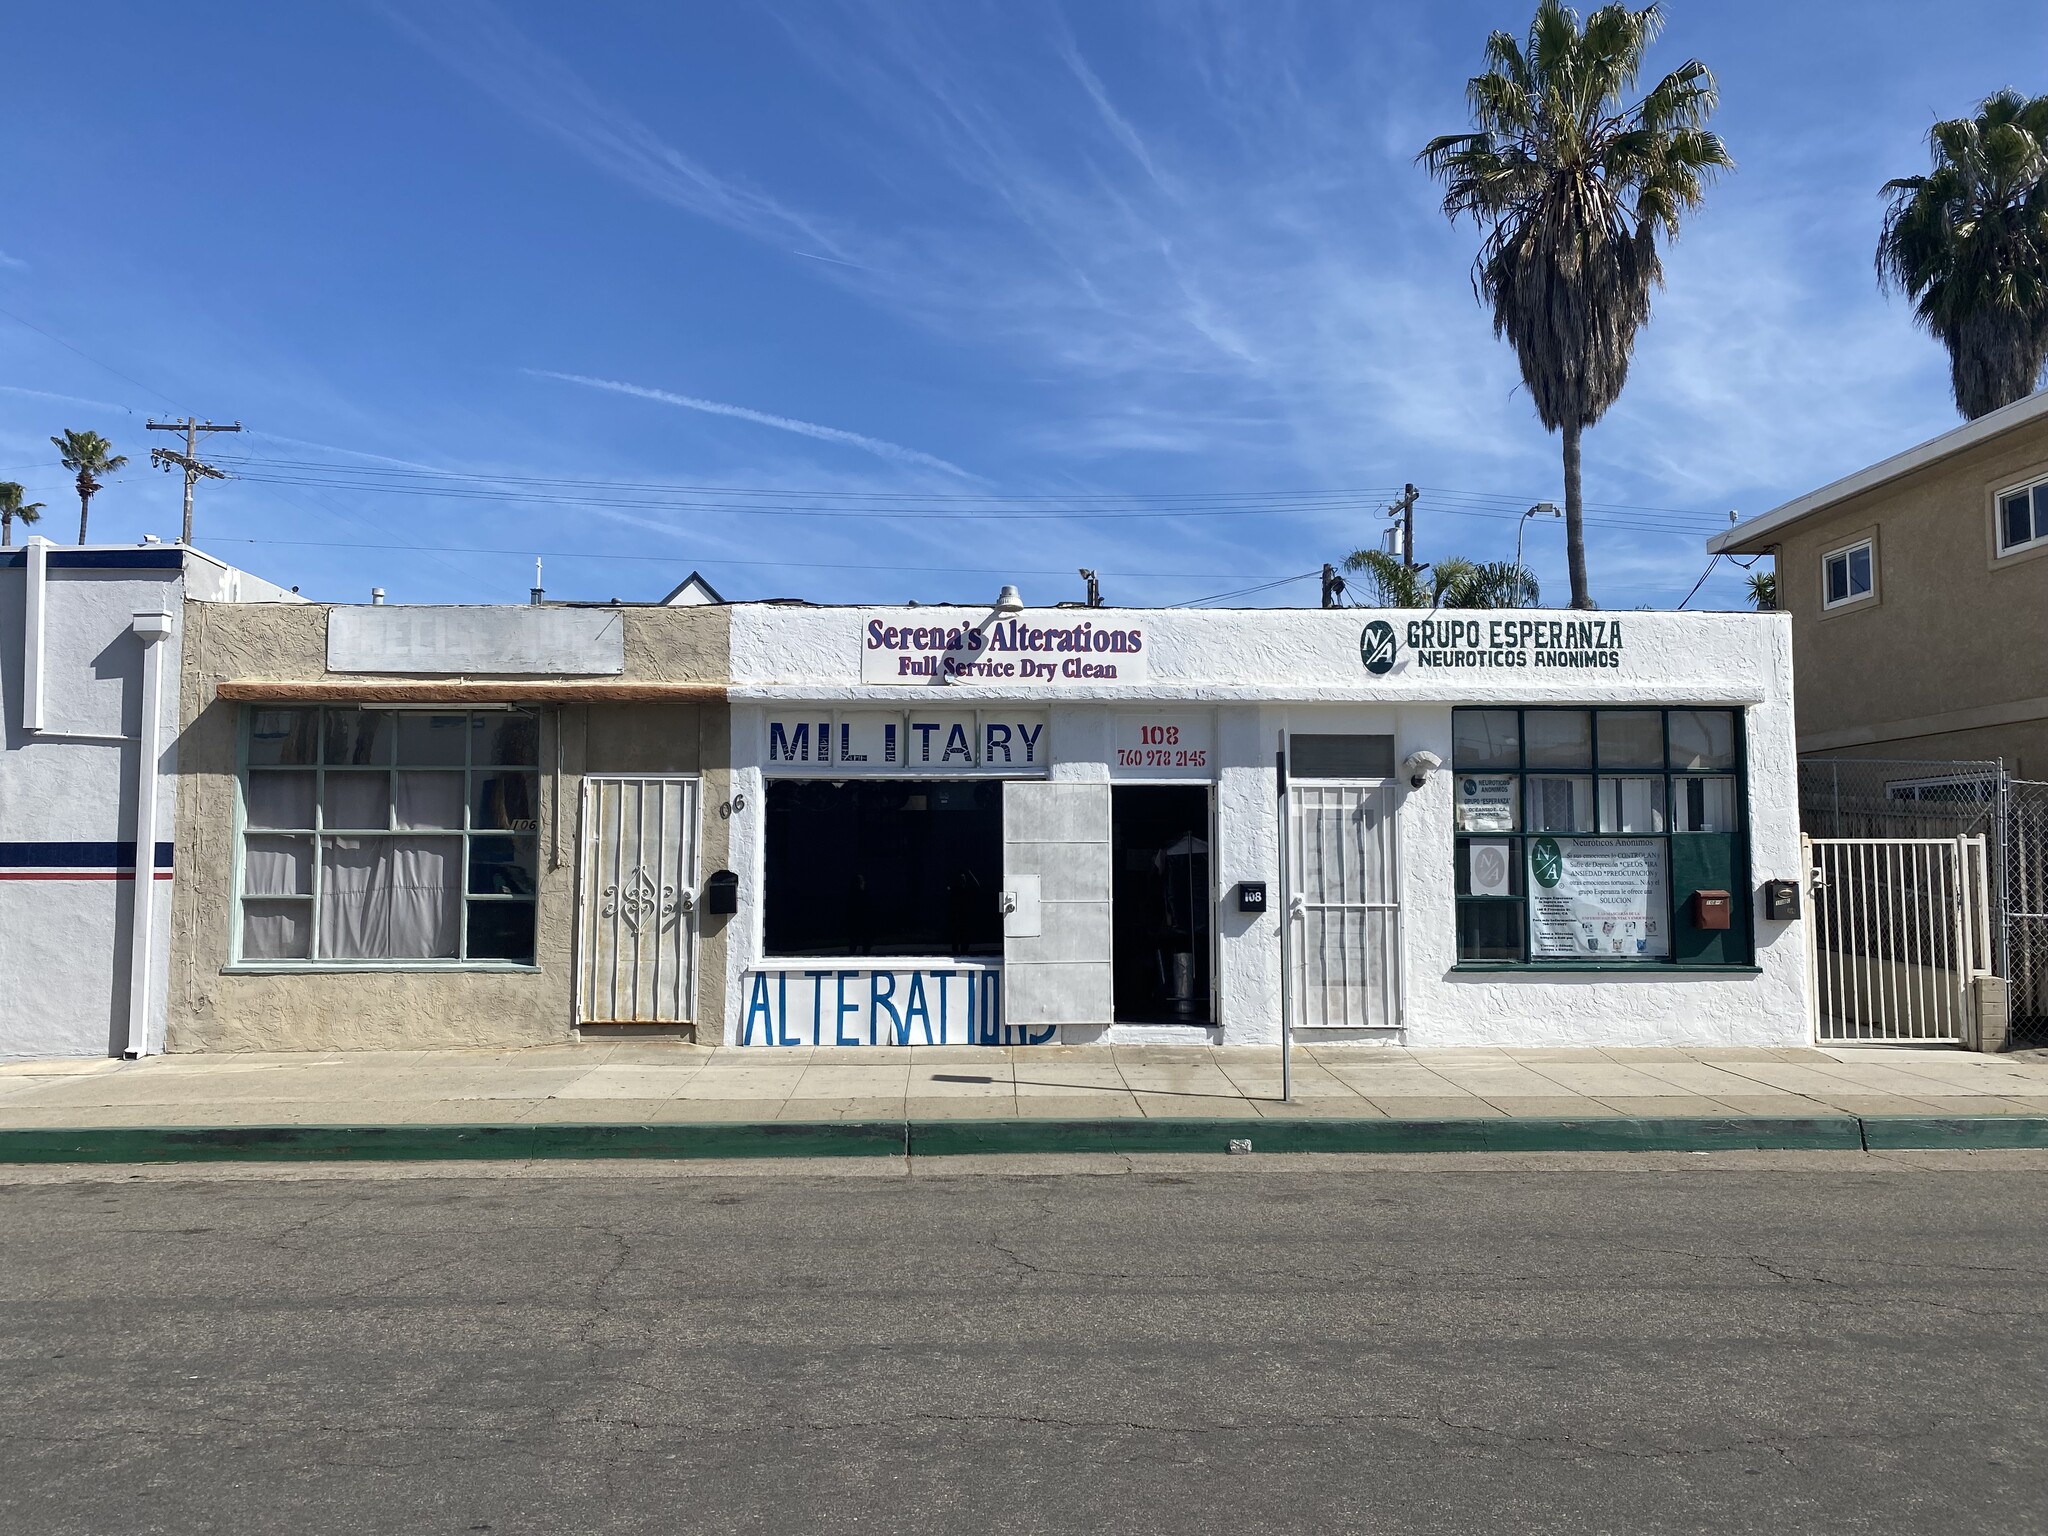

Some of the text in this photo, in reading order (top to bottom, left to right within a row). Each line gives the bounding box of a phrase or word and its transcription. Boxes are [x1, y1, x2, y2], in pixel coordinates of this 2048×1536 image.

[867, 619, 1142, 653] Serena's Alterations
[1407, 620, 1623, 649] GRUPO ESPERANZA
[898, 656, 1118, 682] Full Service Dry Clean
[1418, 650, 1619, 668] NEUROTICOS ANONIMOS
[770, 723, 1044, 762] MILITARY
[1140, 725, 1180, 745] 108
[1117, 749, 1207, 767] 760 978 2145
[512, 819, 537, 831] 106
[1244, 891, 1262, 903] 108
[744, 970, 1058, 1046] ALTERATIO
